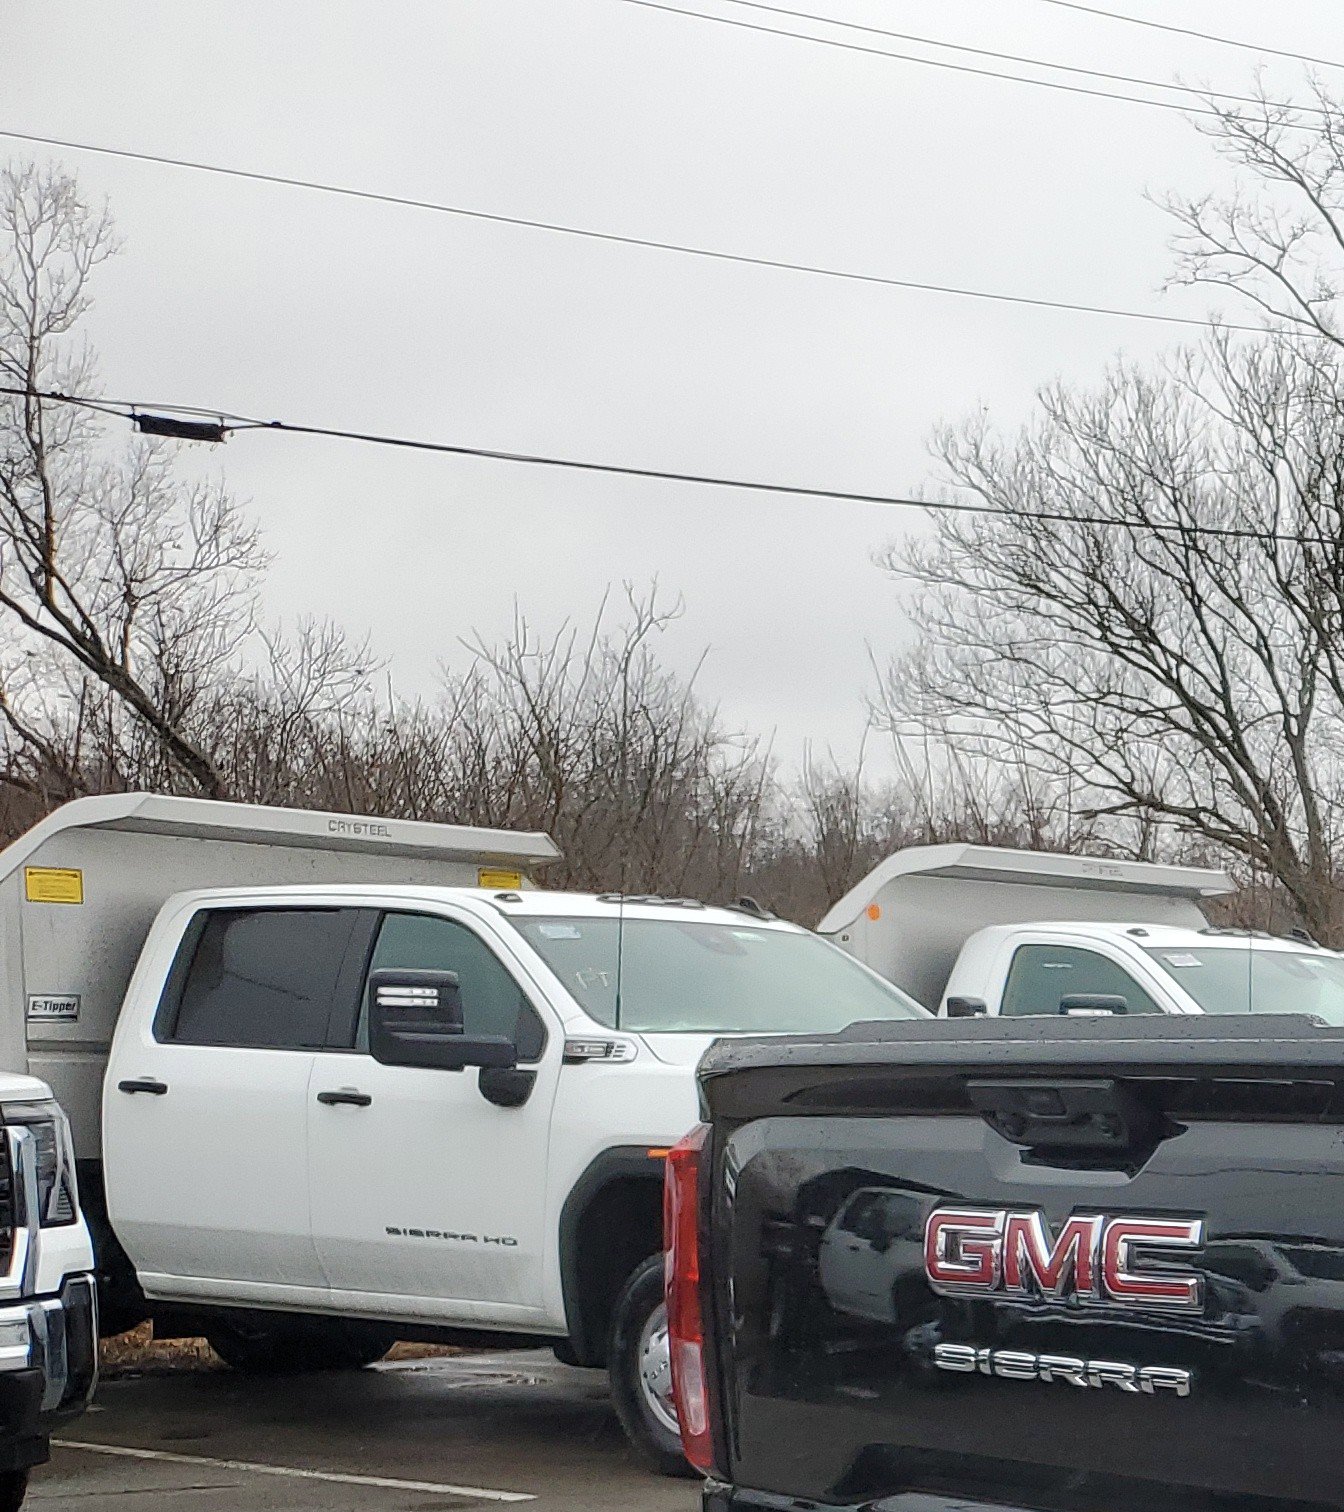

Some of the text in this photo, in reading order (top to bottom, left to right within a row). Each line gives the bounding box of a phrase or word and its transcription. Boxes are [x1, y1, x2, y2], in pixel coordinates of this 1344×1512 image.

[32, 1000, 76, 1013] E-Tipper
[385, 1226, 518, 1246] SIERRA HD
[923, 1205, 1205, 1306] GMC
[933, 1341, 1194, 1396] SIERRA
